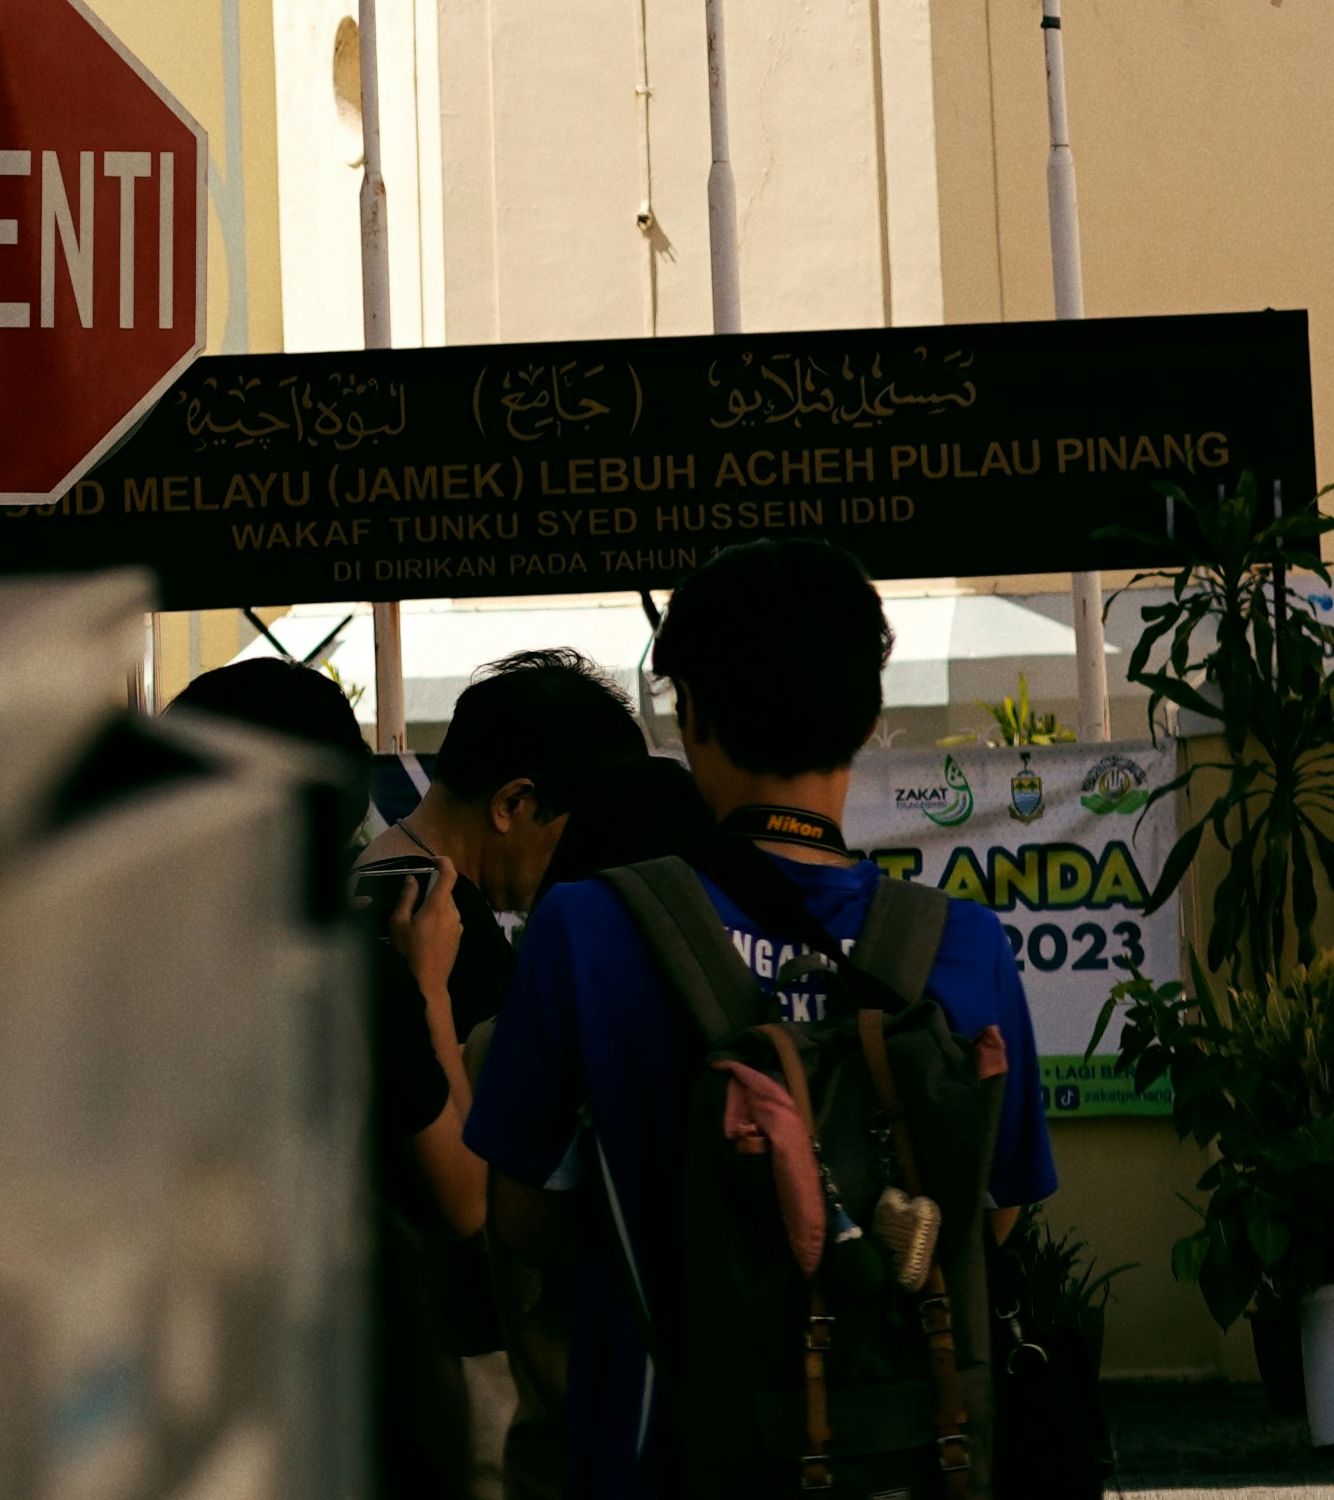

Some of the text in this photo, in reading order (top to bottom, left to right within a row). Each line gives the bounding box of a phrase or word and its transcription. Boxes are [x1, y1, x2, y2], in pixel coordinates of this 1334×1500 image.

[124, 471, 312, 514] MELAYU
[328, 457, 524, 508] (JAMEK)
[540, 454, 695, 495] LEBUH
[714, 447, 875, 488] ACHEH
[890, 438, 1041, 481] PULAU
[1056, 431, 1229, 474] PINANG
[231, 495, 915, 550] WAKAF TUNKU SYED HUSSEIN IDID
[333, 560, 361, 583] DI
[374, 555, 497, 582] DIRIKAN
[509, 552, 589, 577] PADA
[600, 546, 697, 574] TAHUN
[894, 787, 949, 802] ZAKAT
[765, 812, 825, 839] Nikon
[941, 840, 1148, 910] ANDA
[1054, 1065, 1097, 1080] LAGI
